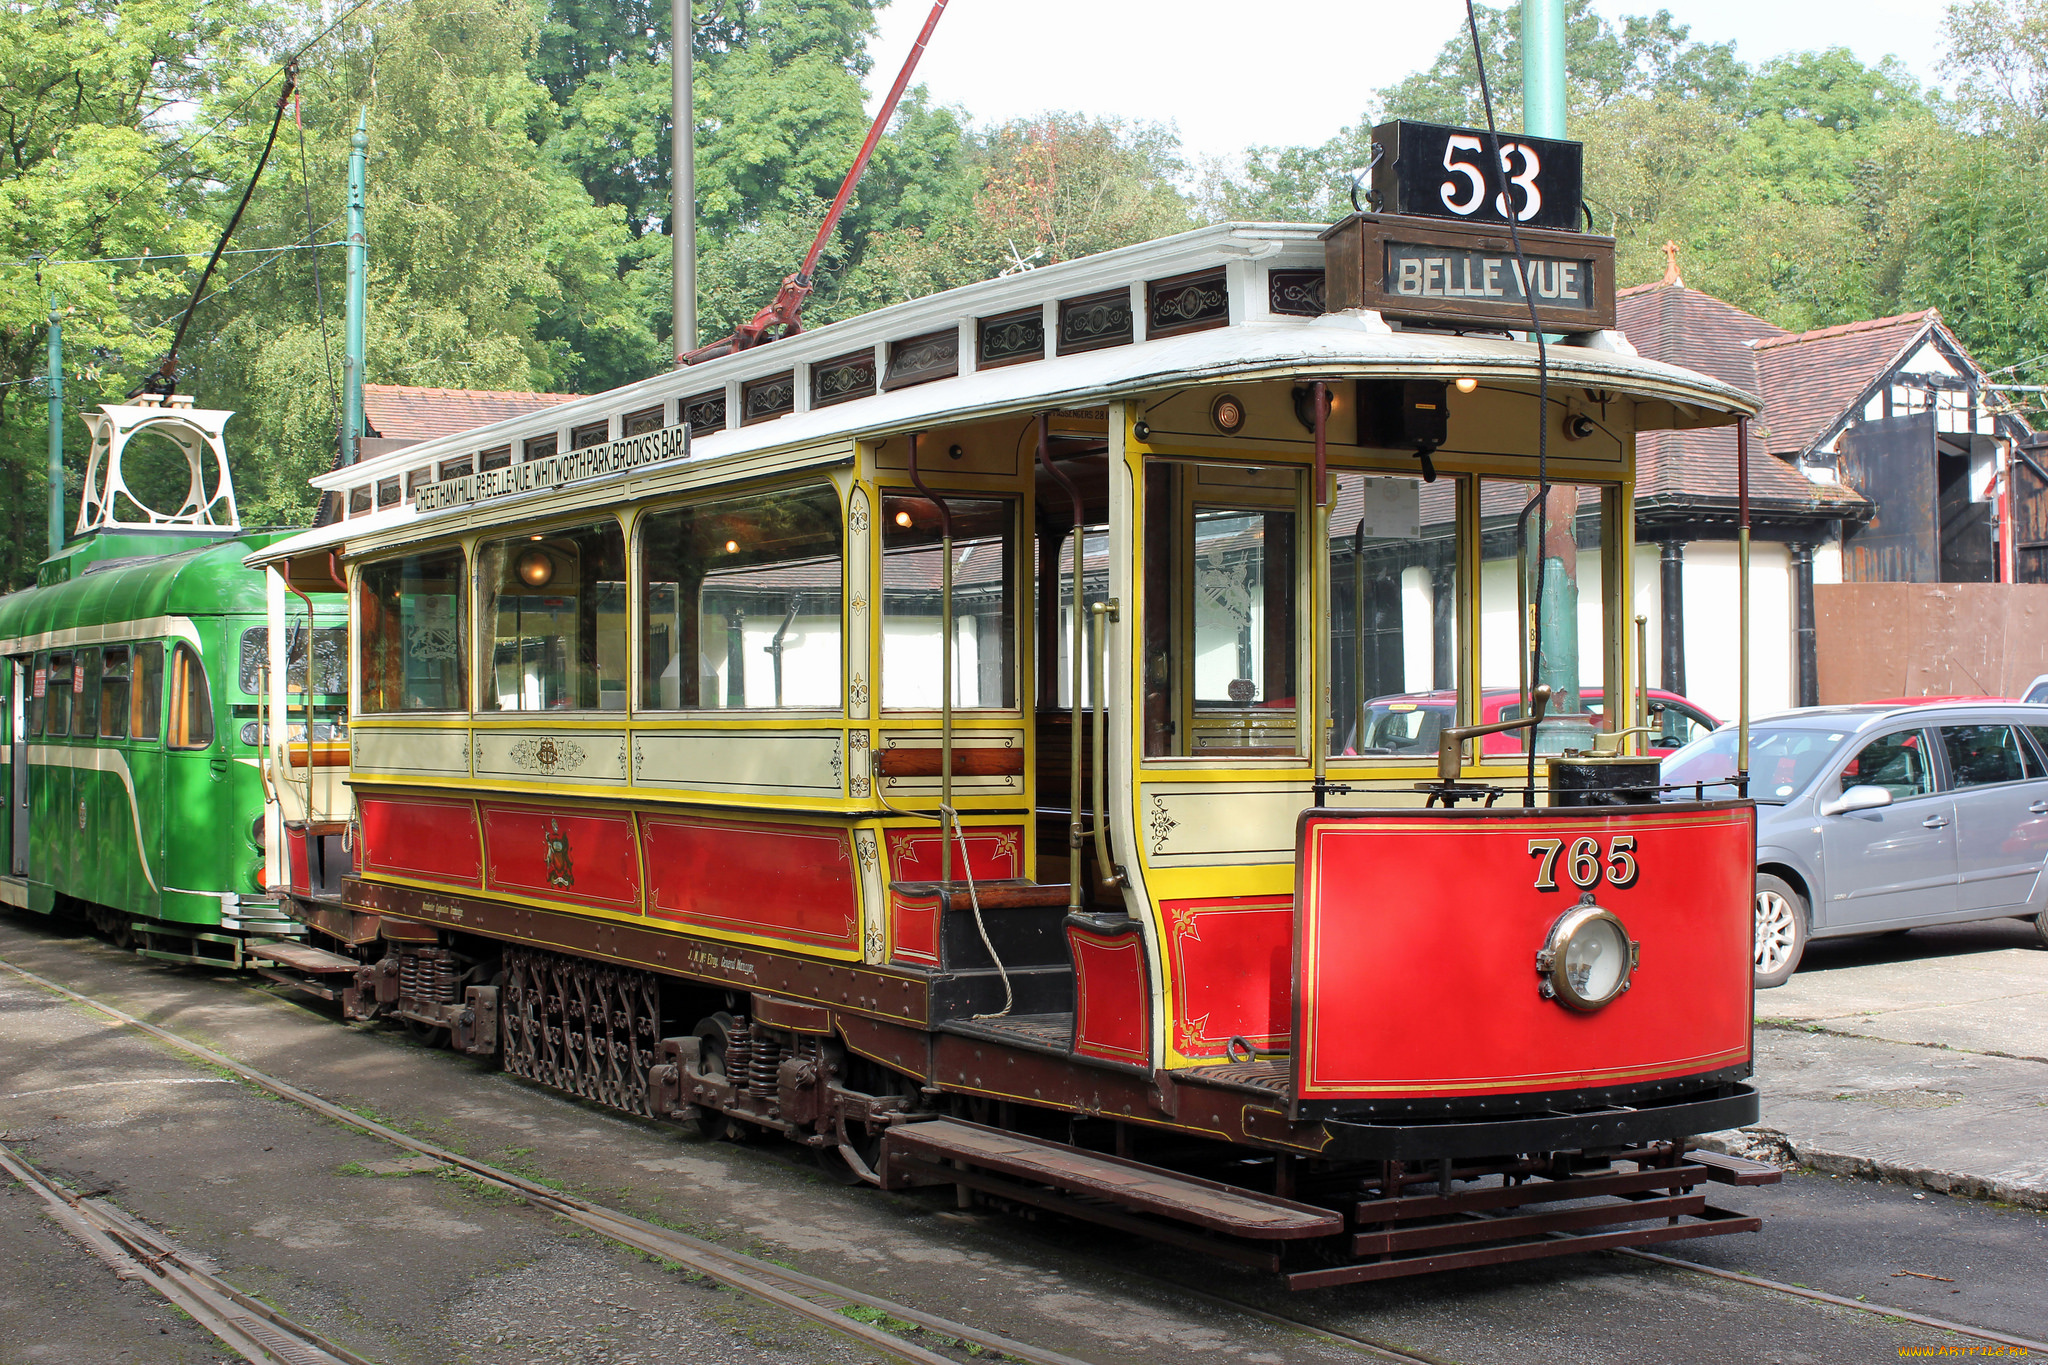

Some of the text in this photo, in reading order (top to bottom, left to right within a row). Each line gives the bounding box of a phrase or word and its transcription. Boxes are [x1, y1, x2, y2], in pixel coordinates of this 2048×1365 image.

[1440, 135, 1541, 221] 53
[1397, 257, 1579, 299] BELLE VUE
[415, 480, 459, 512] CHEETHAM
[458, 478, 475, 502] HILL
[533, 452, 586, 489] WHITWORTH
[612, 432, 660, 471] BROOKS'S
[661, 427, 684, 460] BAR.
[1528, 835, 1640, 893] 765
